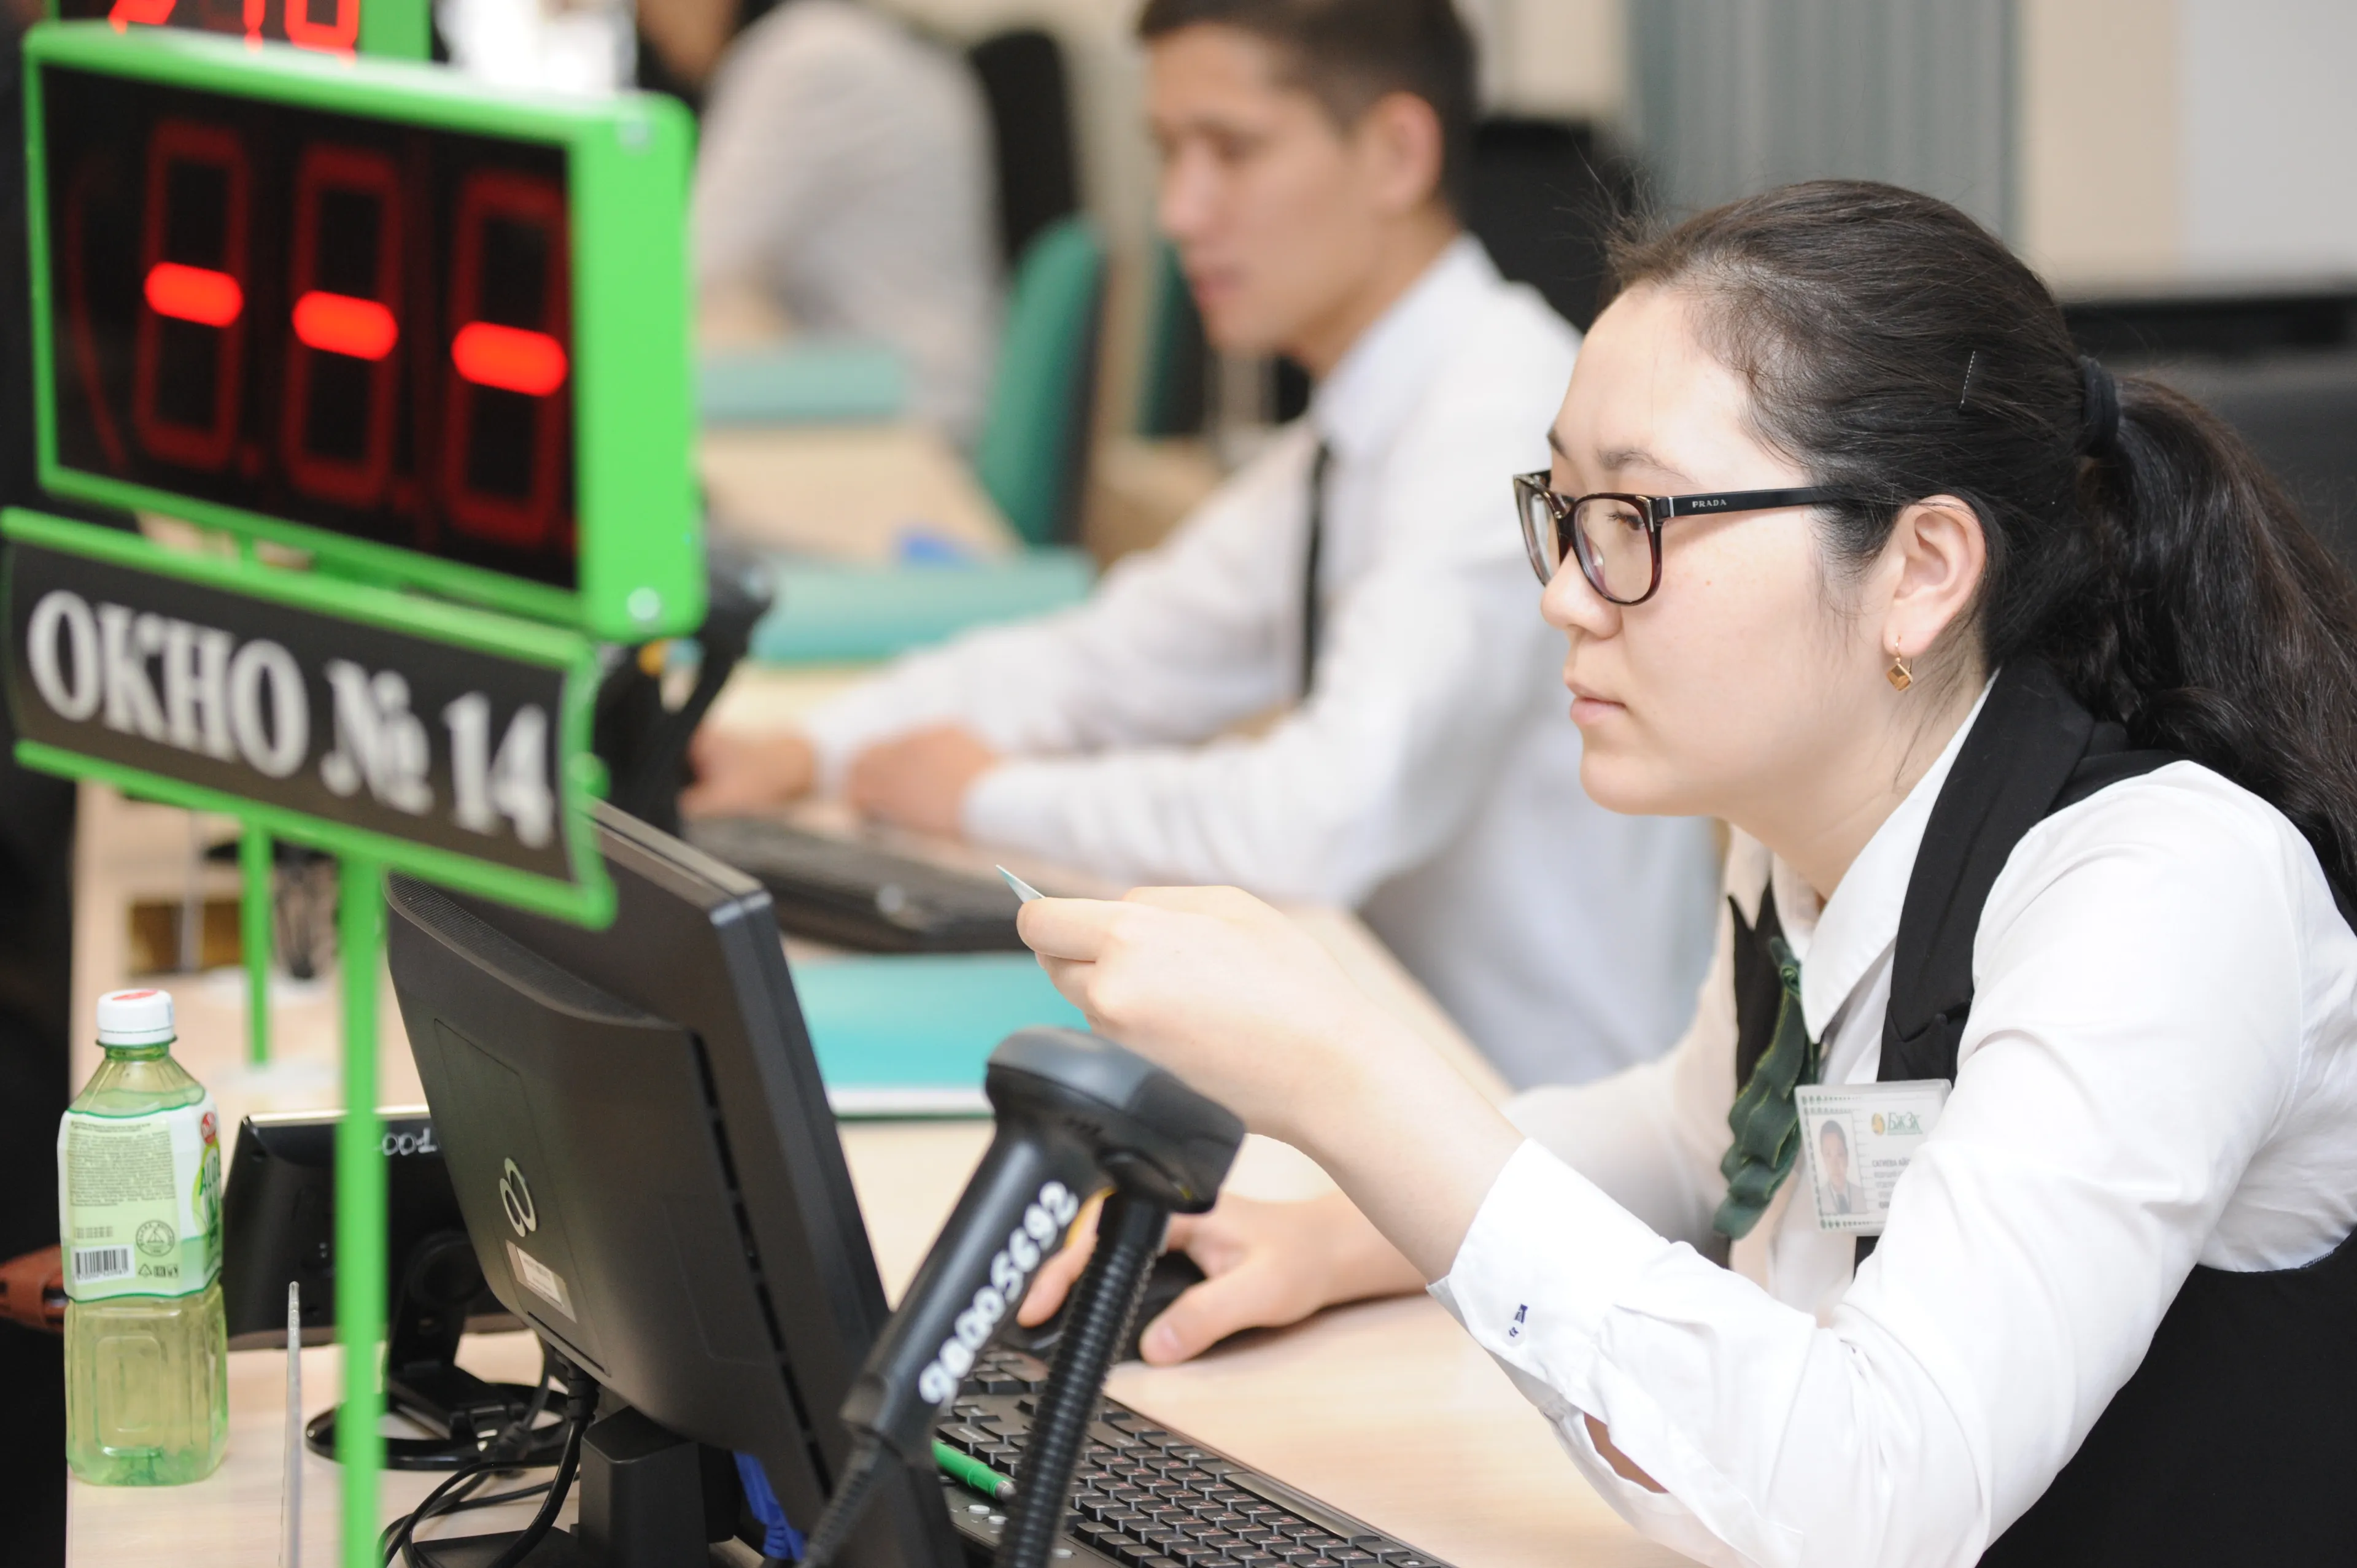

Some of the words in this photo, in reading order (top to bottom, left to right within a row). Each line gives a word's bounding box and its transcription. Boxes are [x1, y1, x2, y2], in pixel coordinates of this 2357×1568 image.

[1692, 498, 1727, 508] PRADA
[28, 590, 308, 778] ОКНО
[320, 659, 435, 816] №
[443, 692, 554, 848] 14
